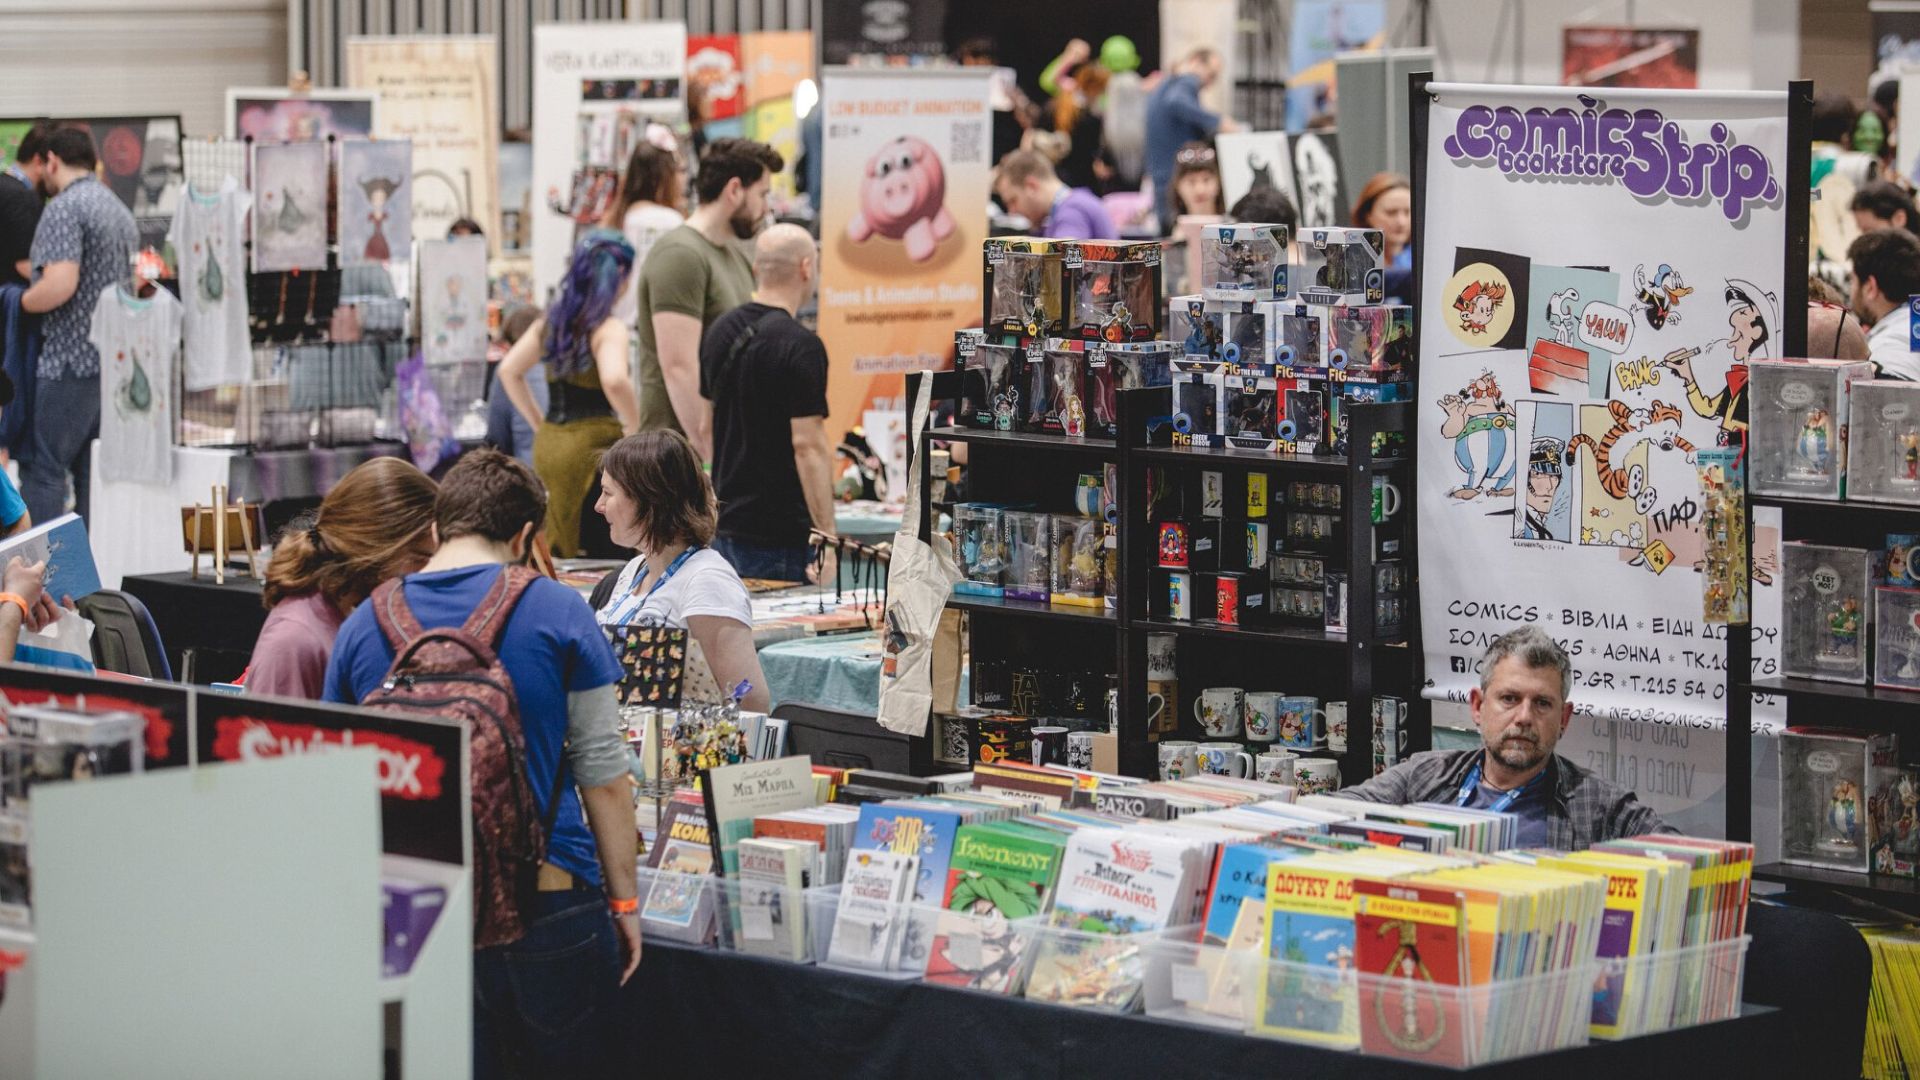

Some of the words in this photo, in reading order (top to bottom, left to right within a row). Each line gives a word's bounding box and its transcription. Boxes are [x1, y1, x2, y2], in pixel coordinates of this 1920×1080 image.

[829, 101, 855, 116] LOW
[859, 100, 908, 116] BUDGET
[913, 100, 982, 116] ANIMATION
[1499, 144, 1626, 178] bookstore
[1585, 314, 1628, 345] YAWN
[1241, 368, 1251, 376] THE
[1251, 369, 1266, 377] HULK
[1615, 355, 1661, 392] BANG
[1562, 609, 1628, 631] ΒΙΒΛΙΑ
[1652, 617, 1694, 637] ΕΙΔΗ
[1702, 623, 1778, 644] ΔΩΟΥ
[1603, 643, 1662, 664] ΑΘΗΝΑ
[1683, 680, 1706, 699] 54
[1163, 685, 1173, 727] TINTIN
[1096, 795, 1145, 818] ΒΑΣΚΟ
